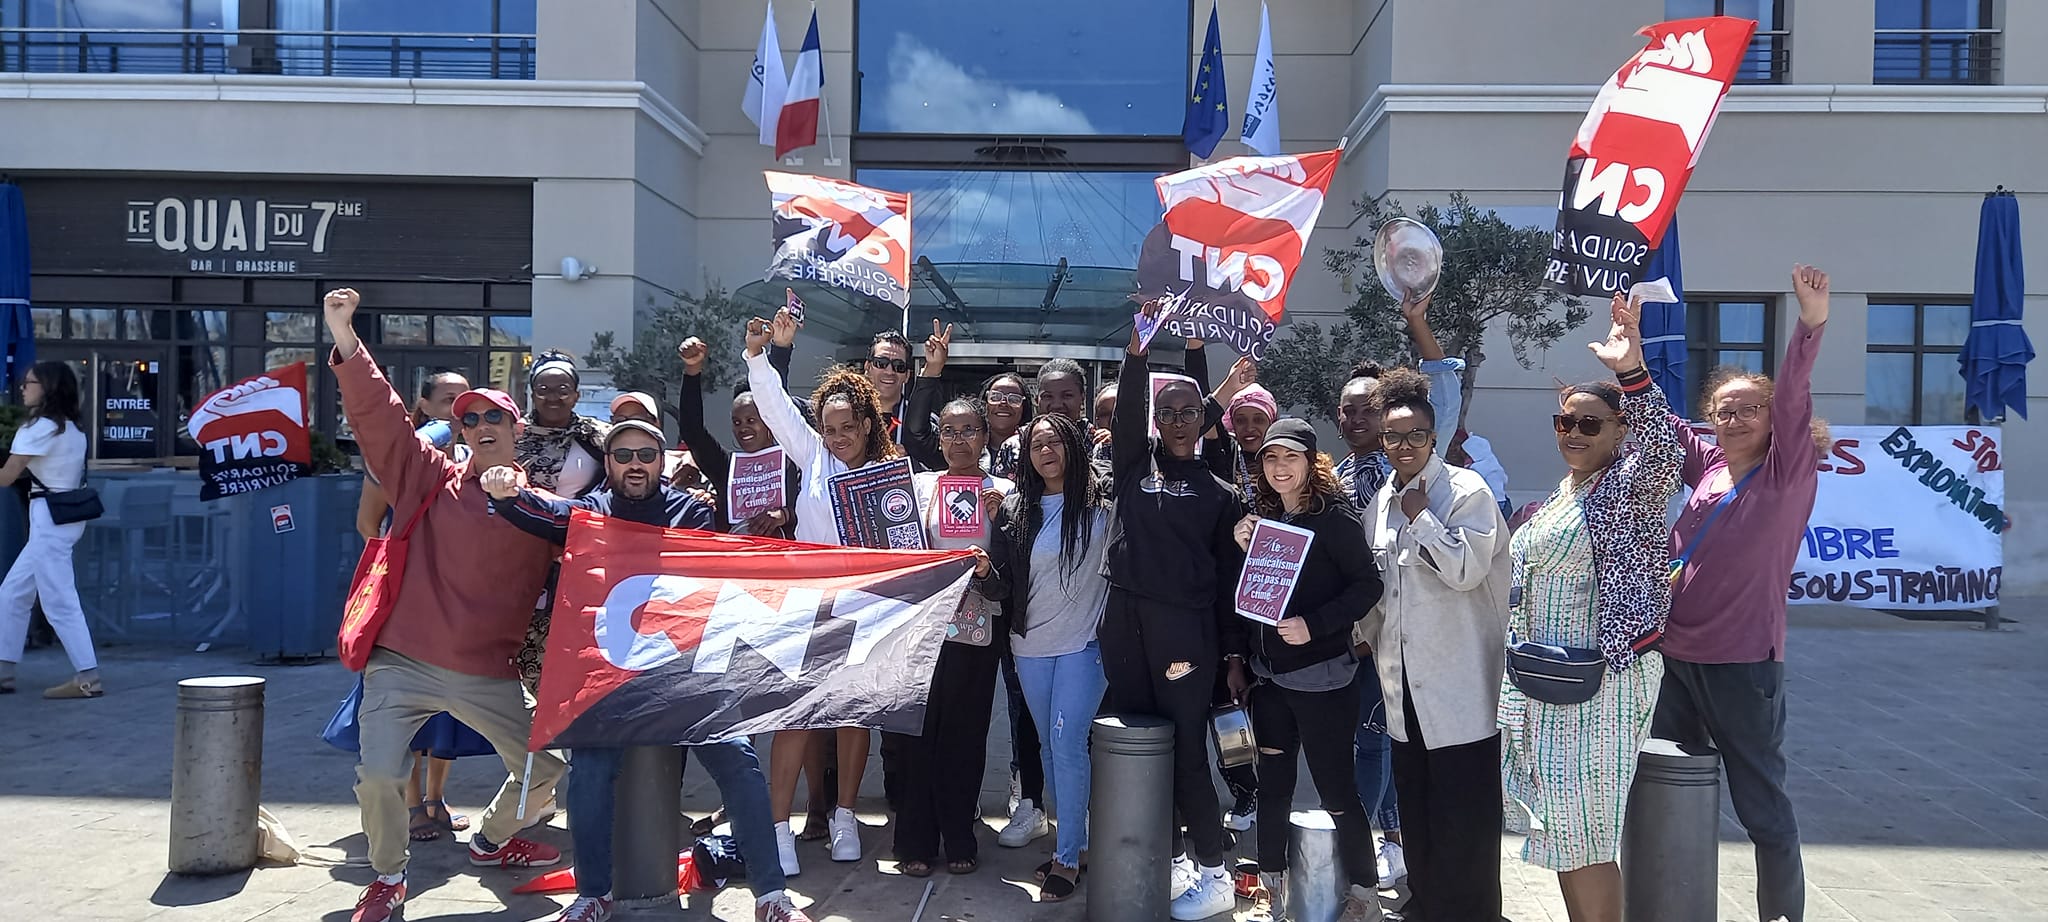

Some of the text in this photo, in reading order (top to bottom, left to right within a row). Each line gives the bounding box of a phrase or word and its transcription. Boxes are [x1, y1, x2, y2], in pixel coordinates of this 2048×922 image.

[128, 210, 150, 233] LE
[155, 198, 266, 252] QUAI
[274, 213, 303, 236] DU
[191, 260, 296, 272] BAR BRASSERIE
[110, 426, 134, 439] QUAI
[1952, 430, 2001, 473] STO
[732, 469, 782, 484] syndicalisme
[745, 497, 767, 508] crime
[1247, 557, 1299, 571] syndicalisme
[1265, 575, 1280, 585] pas
[1280, 576, 1292, 586] un
[594, 574, 923, 682] CNT
[1169, 661, 1190, 674] NIKE
